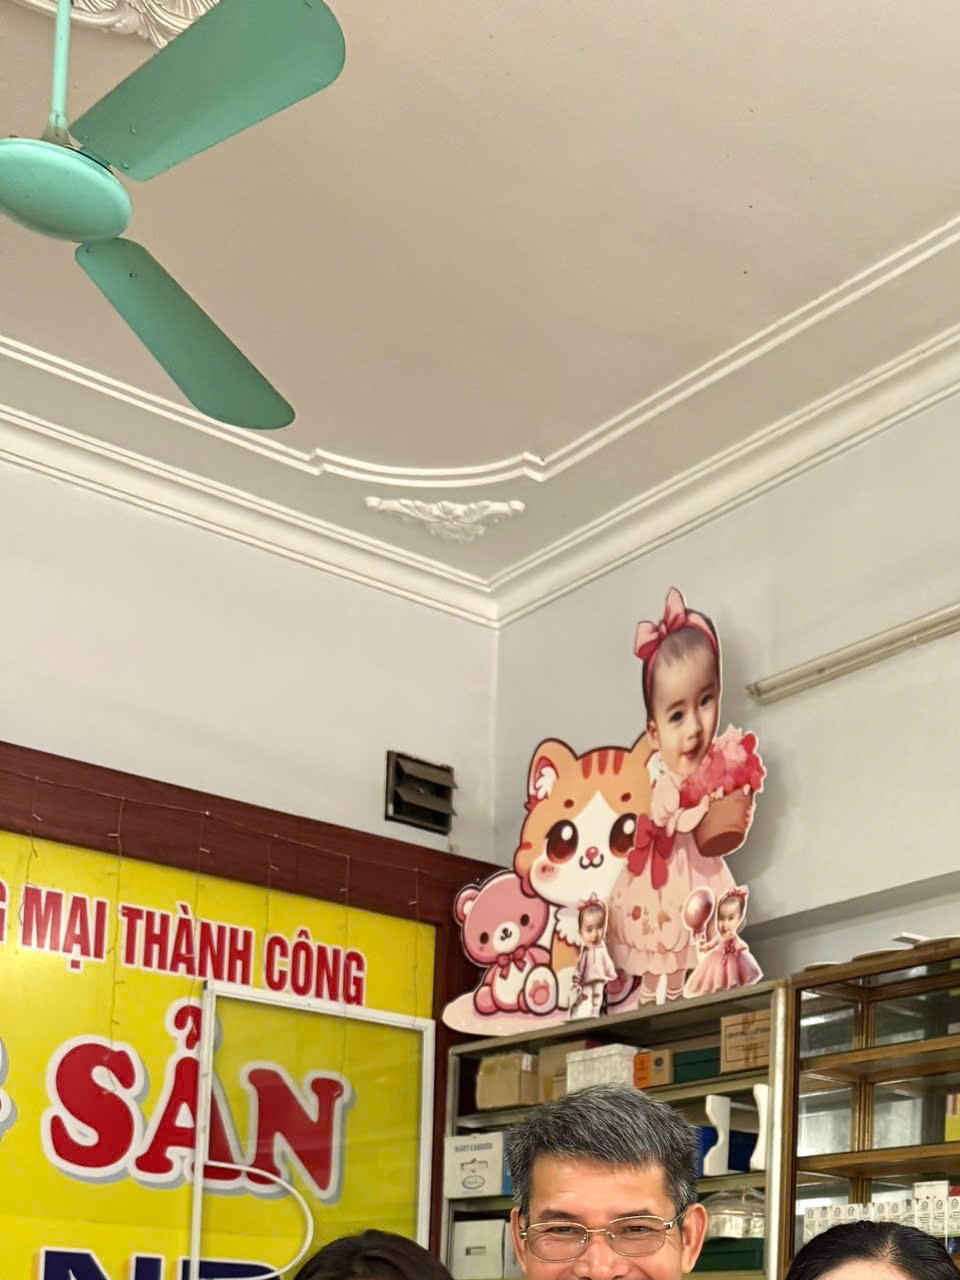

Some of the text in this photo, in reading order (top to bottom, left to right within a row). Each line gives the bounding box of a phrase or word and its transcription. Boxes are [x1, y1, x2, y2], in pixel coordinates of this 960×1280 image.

[22, 886, 106, 970] MẠI
[120, 903, 253, 986] THÀNH
[265, 928, 366, 1006] CÔNG
[49, 1003, 346, 1194] SẢN
